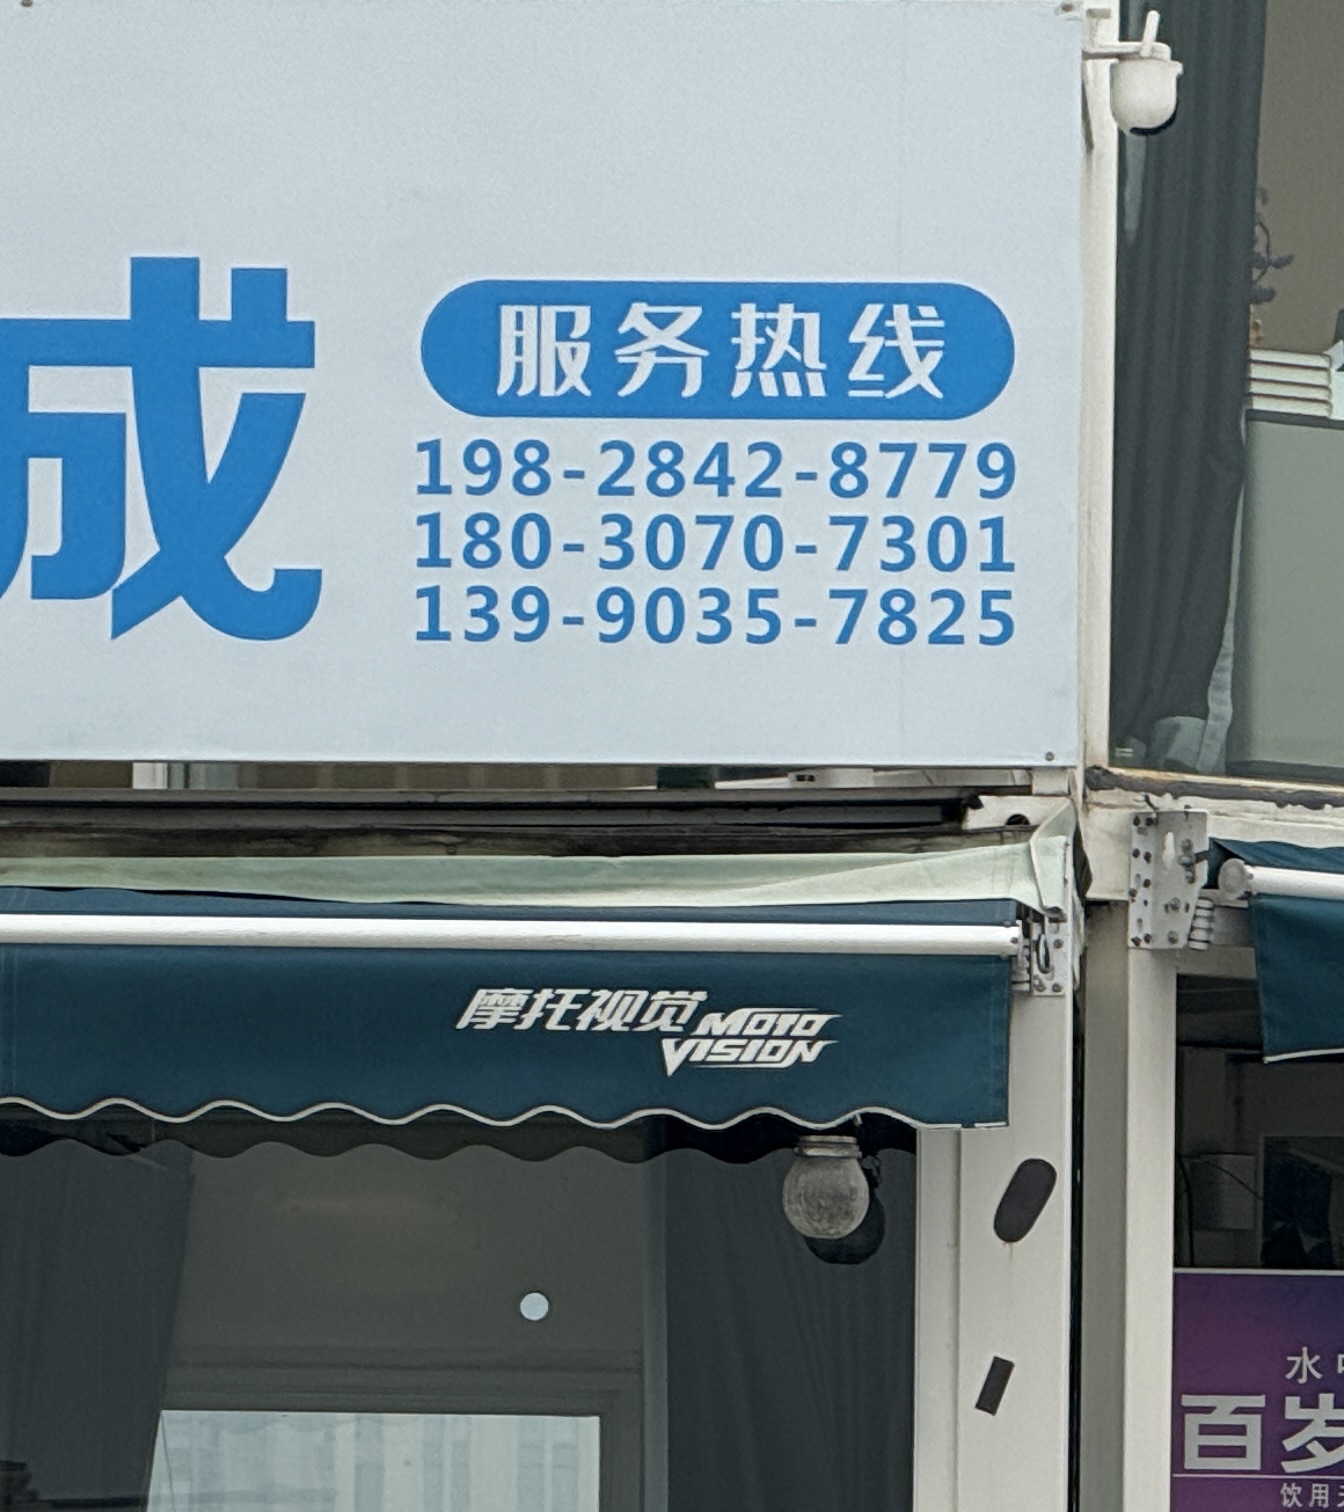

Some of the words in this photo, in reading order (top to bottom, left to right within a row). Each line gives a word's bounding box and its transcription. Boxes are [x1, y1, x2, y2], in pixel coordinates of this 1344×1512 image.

[495, 301, 945, 400] 服务热线
[415, 438, 1016, 500] 198-2842-8779
[415, 511, 1016, 573] 180-3070-7301
[415, 584, 1016, 646] 139-9035-7825
[455, 987, 709, 1033] 摩托视觉
[660, 1038, 838, 1077] VISION
